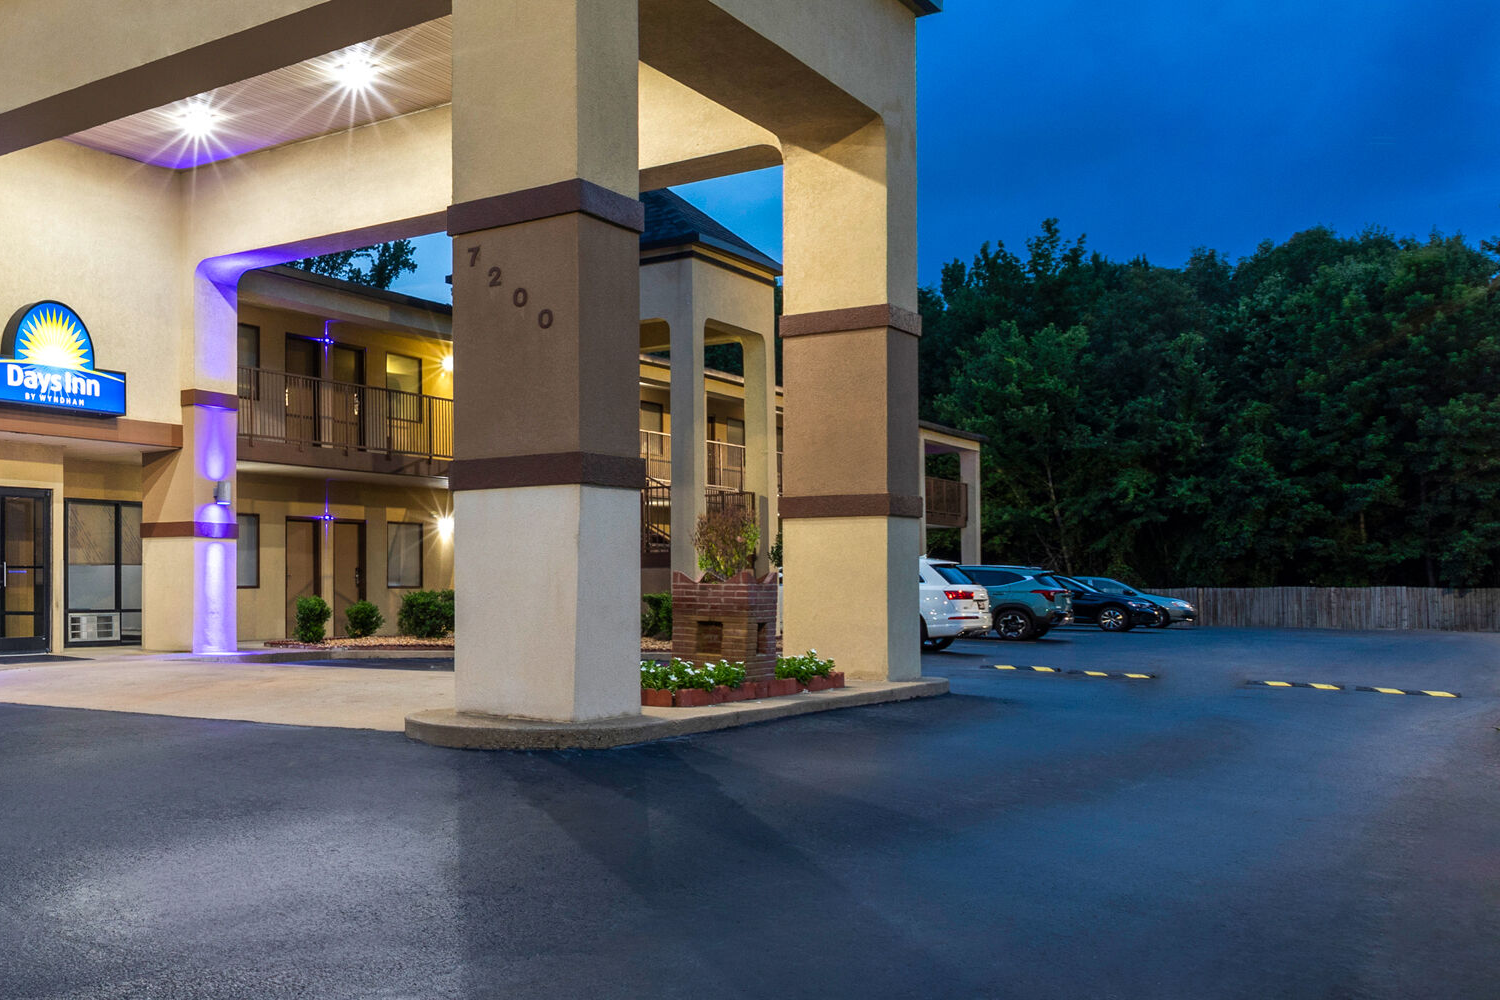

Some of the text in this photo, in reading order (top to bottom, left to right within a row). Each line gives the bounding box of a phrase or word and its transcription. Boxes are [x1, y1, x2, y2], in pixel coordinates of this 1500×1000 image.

[7, 364, 100, 397] Days Inn
[25, 392, 85, 406] BY WYNDHAM
